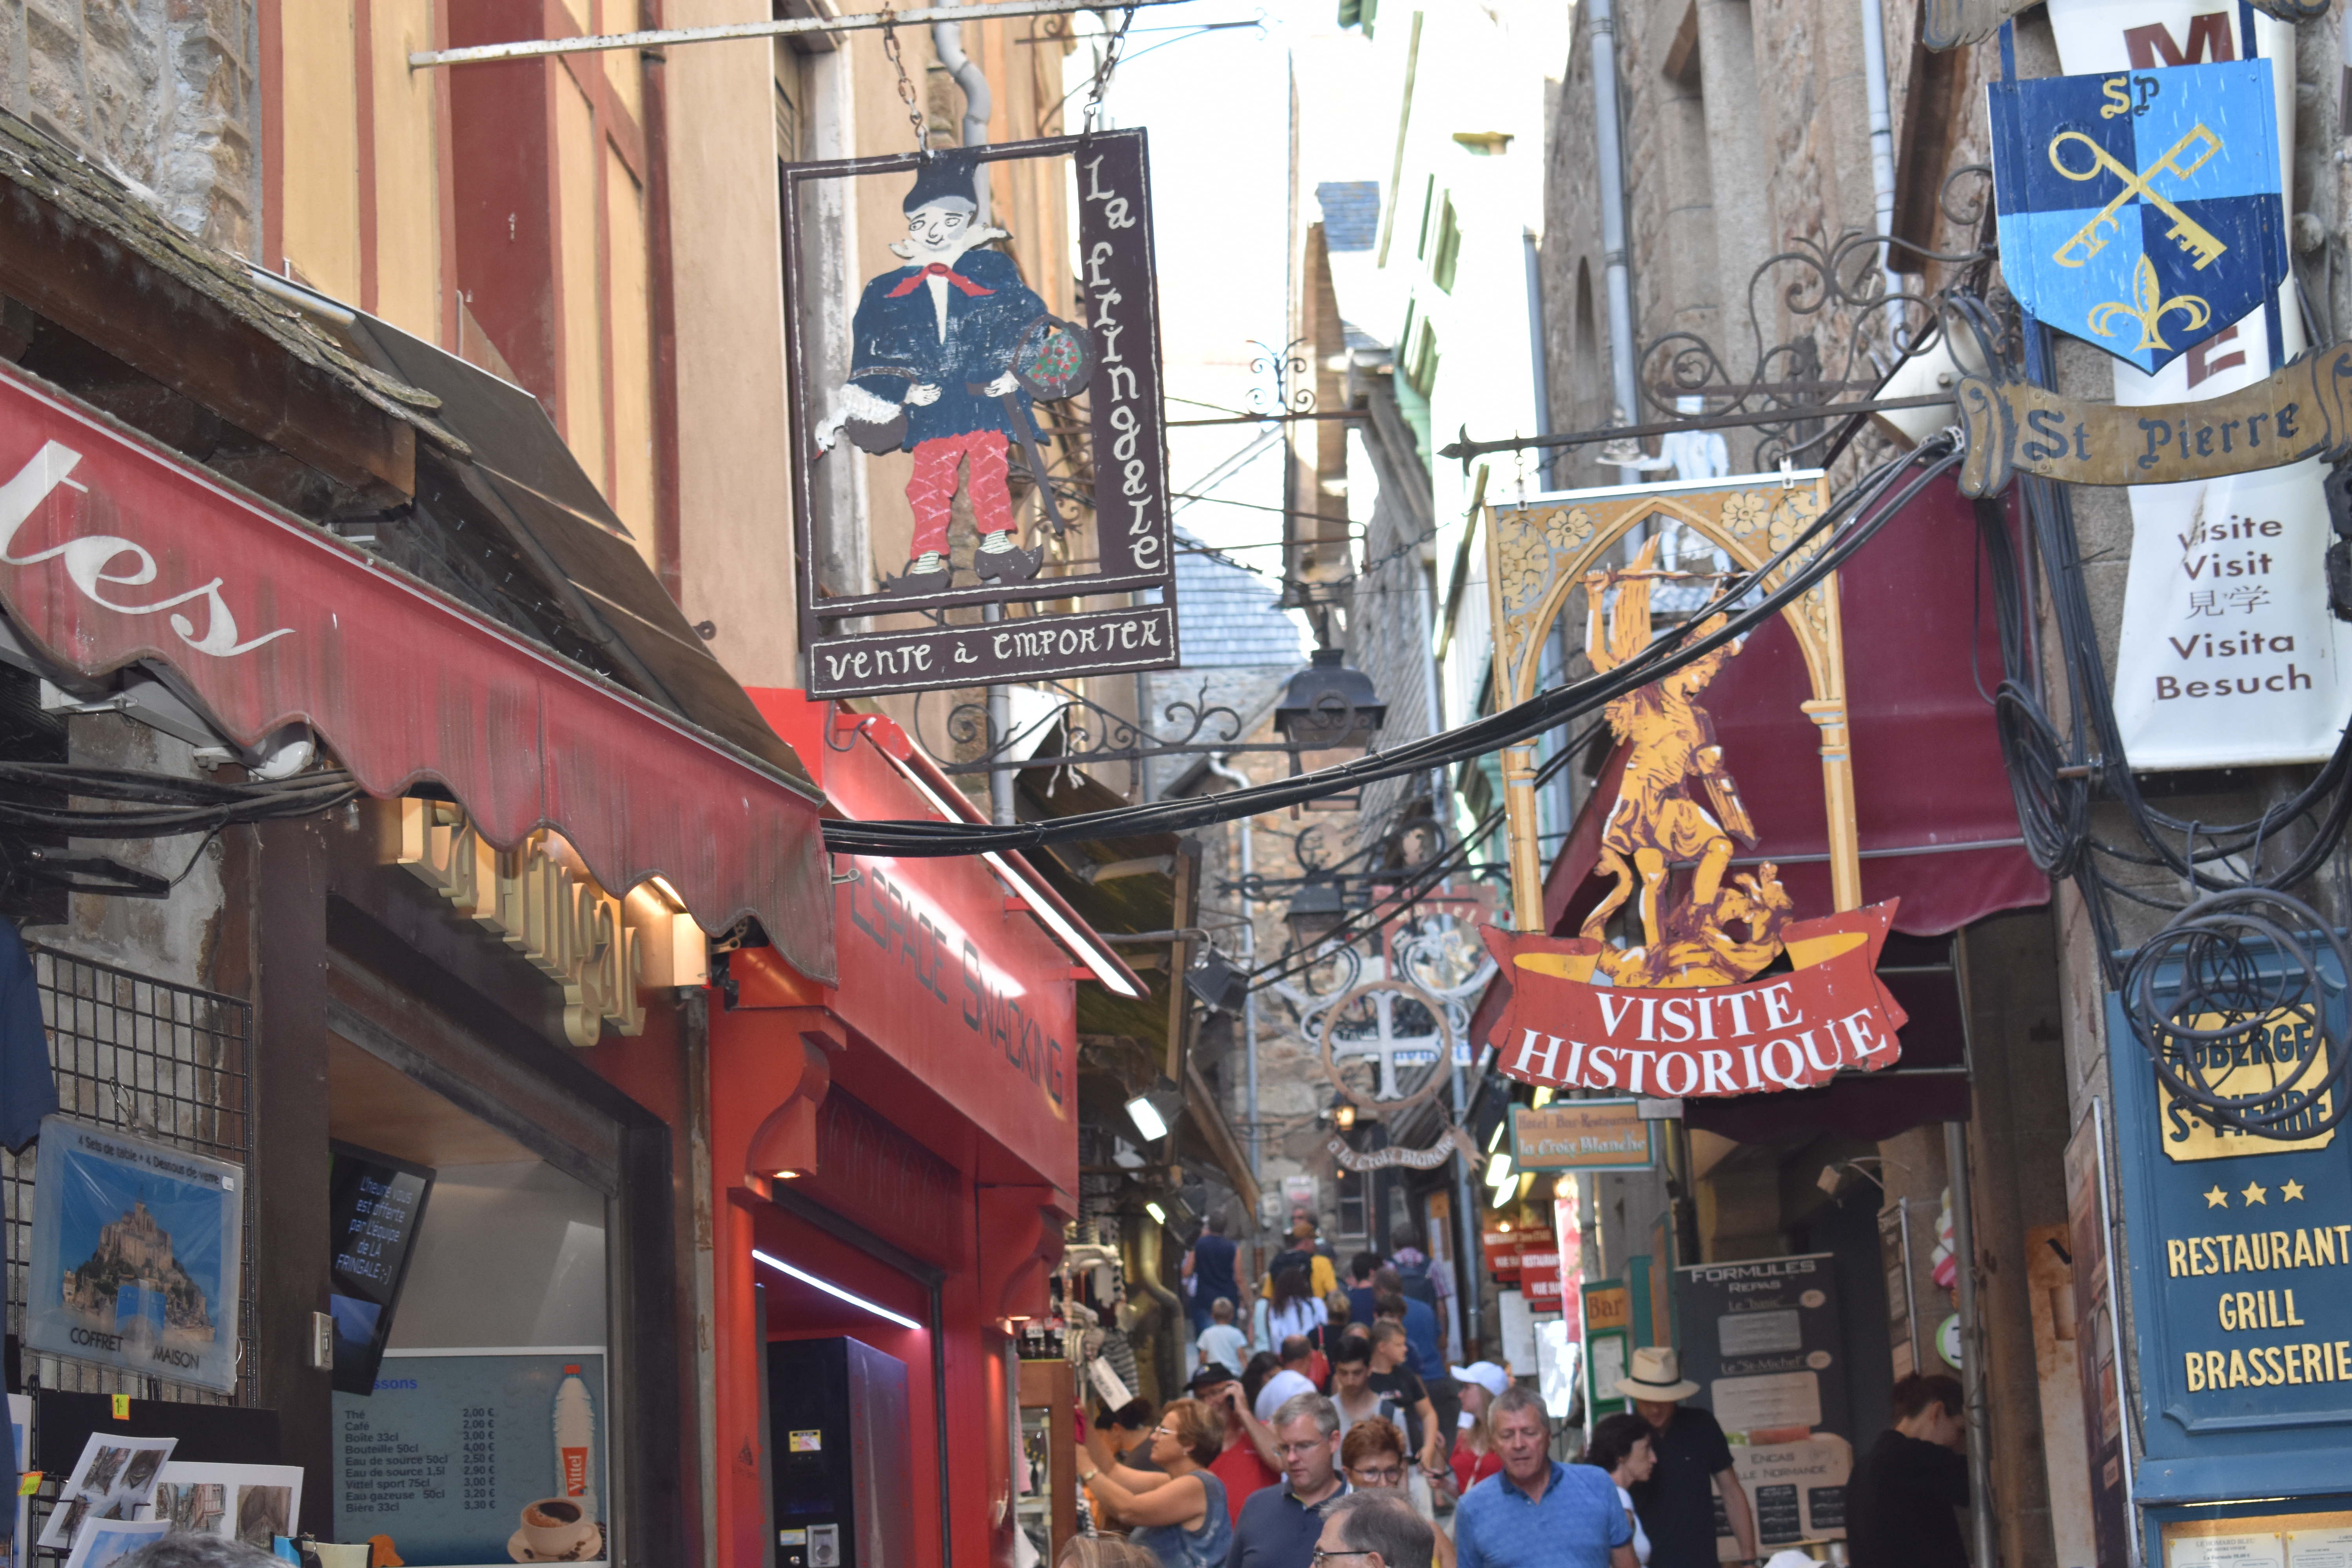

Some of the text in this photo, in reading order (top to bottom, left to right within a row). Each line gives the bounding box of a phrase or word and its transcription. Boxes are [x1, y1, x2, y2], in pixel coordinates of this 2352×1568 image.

[2022, 402, 2300, 470] St Pierre
[2178, 515, 2283, 550] Visite
[2183, 551, 2273, 581] Visit
[2185, 586, 2270, 620] 見学
[2169, 631, 2294, 661] Visita
[2156, 664, 2312, 701] Besuch
[963, 938, 1062, 1105] SNACKING
[1595, 981, 1802, 1043] VISITE
[1511, 1008, 1886, 1095] HISTORIQUE
[103, 1142, 114, 1156] de
[1535, 1137, 1578, 1159] Croix
[1578, 1133, 1646, 1156] Blanche
[348, 1218, 367, 1234] par
[357, 1239, 369, 1255] de
[2167, 1225, 2351, 1278] RESTAURANT
[336, 1253, 381, 1279] FRINGALE
[1691, 1259, 1817, 1284] FORMULES
[1589, 1296, 1624, 1319] Bar
[2218, 1289, 2305, 1331] GRILL
[71, 1327, 200, 1370] COFFRET MAISON
[2185, 1341, 2352, 1392] BRASSERIE
[373, 1378, 418, 1390] ssons
[345, 1422, 370, 1431] Café
[376, 1433, 399, 1442] 33cl
[345, 1445, 394, 1455] Bouteille
[397, 1444, 418, 1453] 50cl
[345, 1457, 366, 1466] Eau
[370, 1456, 383, 1465] de
[426, 1455, 448, 1464] 50cl
[1751, 1452, 1795, 1465] ENCAS
[345, 1468, 366, 1477] Eau
[370, 1468, 383, 1477] de
[386, 1468, 423, 1477] source
[345, 1480, 373, 1489] Vittel
[377, 1479, 405, 1490] sport
[408, 1478, 431, 1488] 75cl
[568, 1455, 582, 1491] Vittel
[346, 1492, 367, 1501] Eau
[370, 1492, 415, 1503] gazeuse
[423, 1490, 445, 1499] 50cl
[377, 1502, 399, 1512] 33cl
